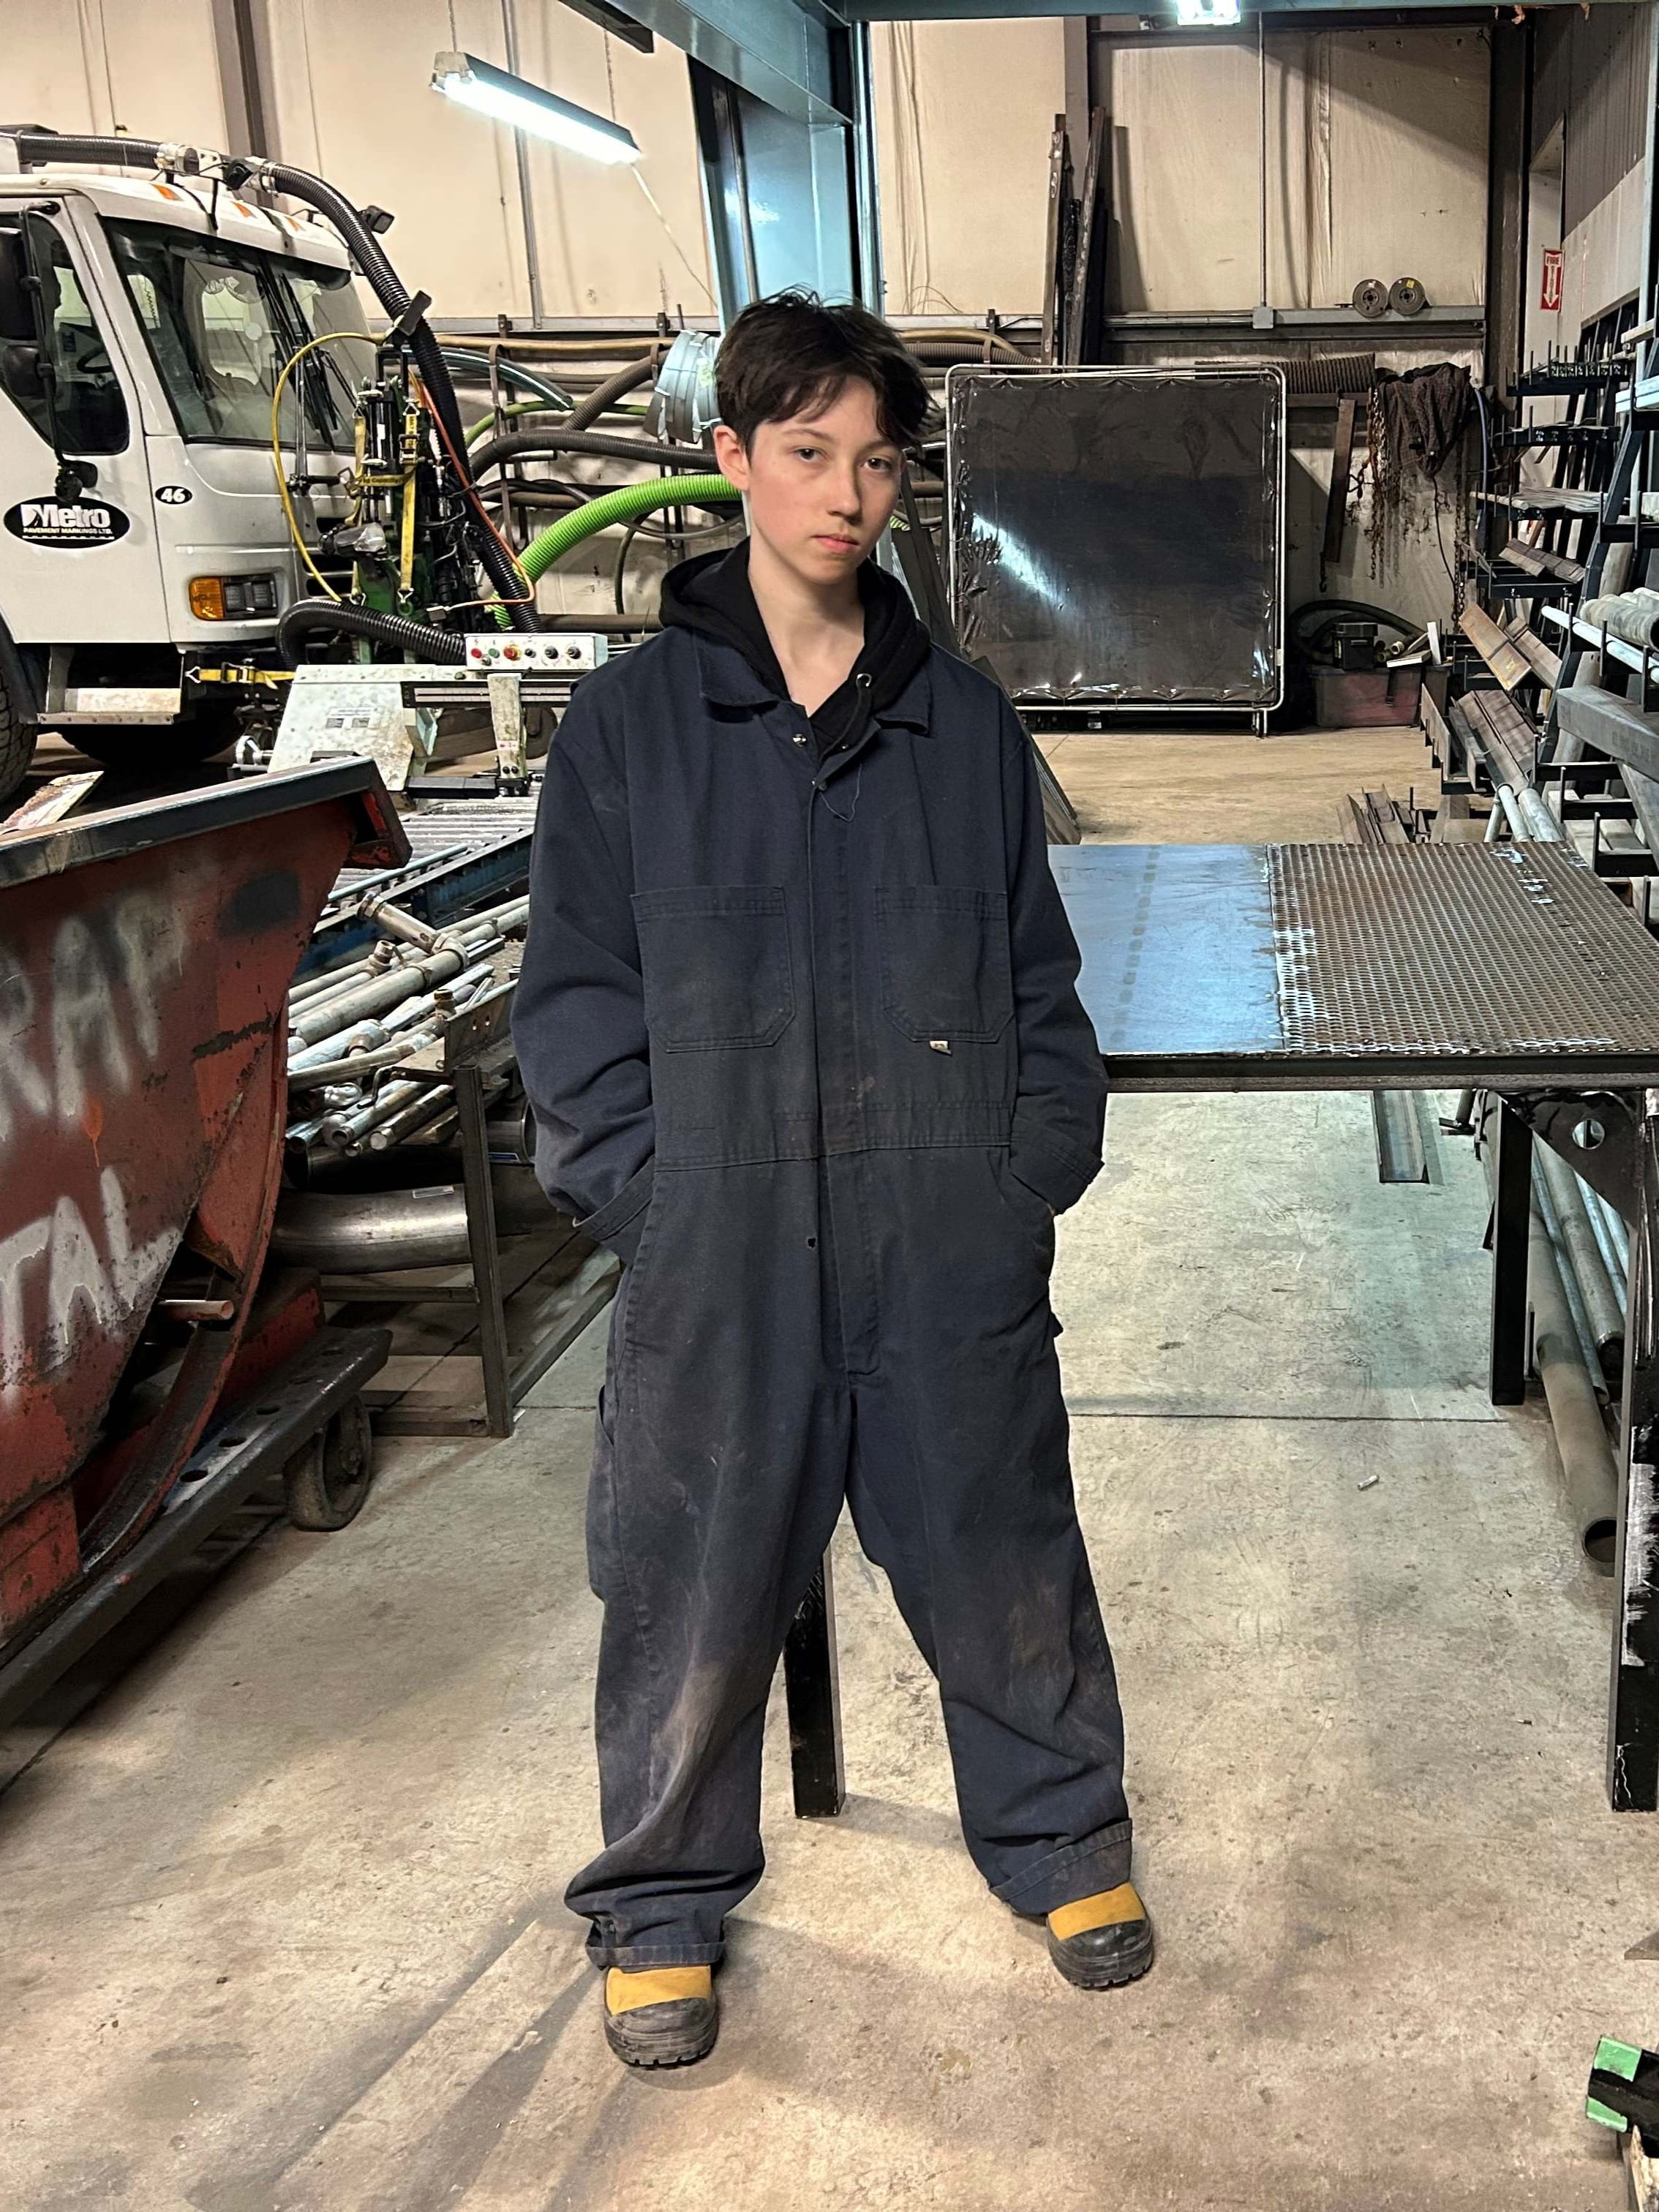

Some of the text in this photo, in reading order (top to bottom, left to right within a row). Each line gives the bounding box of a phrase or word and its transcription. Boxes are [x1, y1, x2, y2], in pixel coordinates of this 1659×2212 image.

[1547, 256, 1560, 265] FIRE
[161, 488, 185, 503] 46
[20, 504, 110, 527] Metro
